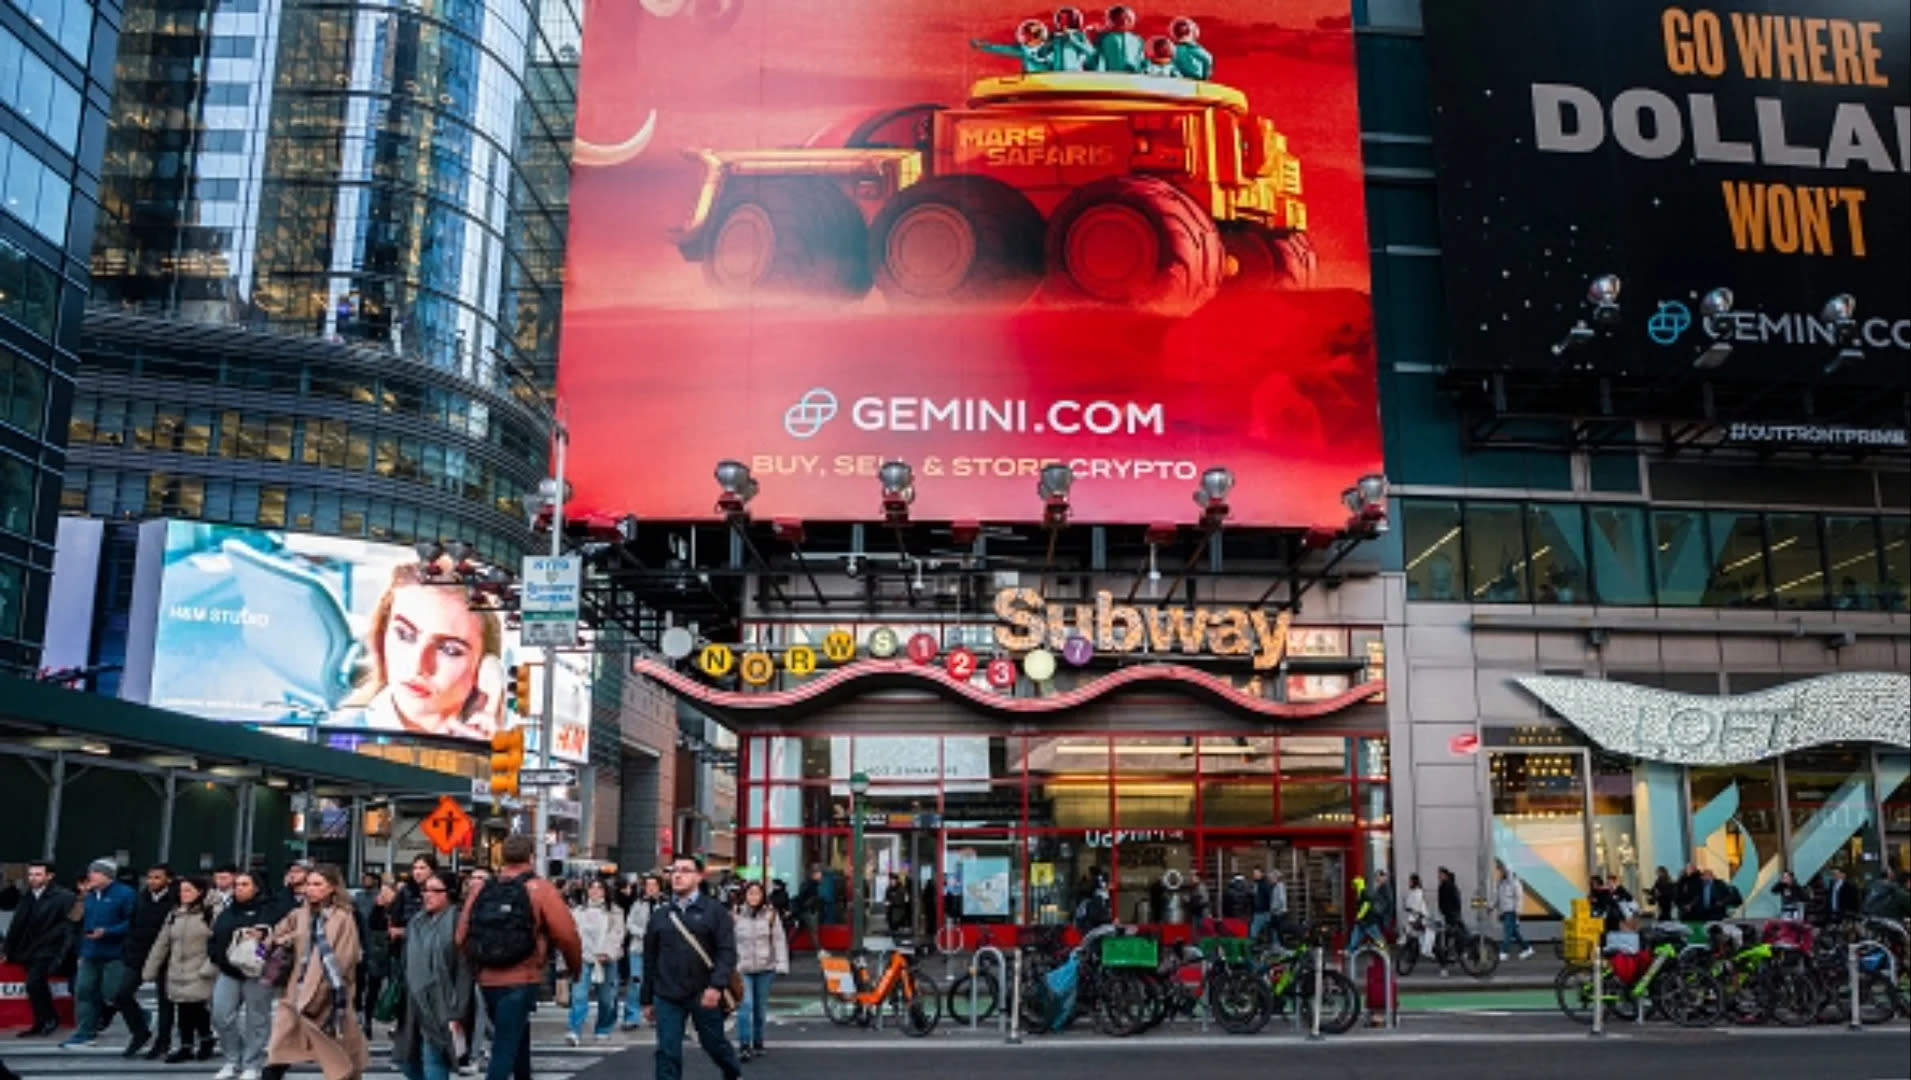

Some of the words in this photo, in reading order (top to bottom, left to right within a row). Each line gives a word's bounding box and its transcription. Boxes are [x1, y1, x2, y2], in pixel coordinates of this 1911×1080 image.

[1661, 6, 1726, 77] GO
[1730, 12, 1889, 87] WHERE
[959, 126, 1046, 147] MARS
[1531, 83, 1911, 173] DOLLA
[987, 144, 1115, 167] SAFARIS
[1722, 180, 1867, 256] WON'T
[1703, 312, 1910, 349] EMIN.CO
[852, 396, 1165, 435] GEMINI.COM
[752, 454, 826, 479] BUY,
[833, 455, 903, 477] SE
[922, 456, 945, 477] &
[1069, 458, 1198, 480] CRYPTO
[208, 608, 270, 628] STUDIO
[994, 587, 1292, 669] Subway
[707, 646, 726, 672] N
[791, 646, 812, 672] R
[826, 632, 852, 658] W
[875, 631, 893, 653] S
[917, 633, 931, 656] 1
[955, 651, 971, 677] 2
[994, 662, 1010, 685] 3
[1071, 638, 1084, 661] 7
[1634, 701, 1804, 752] LOFT
